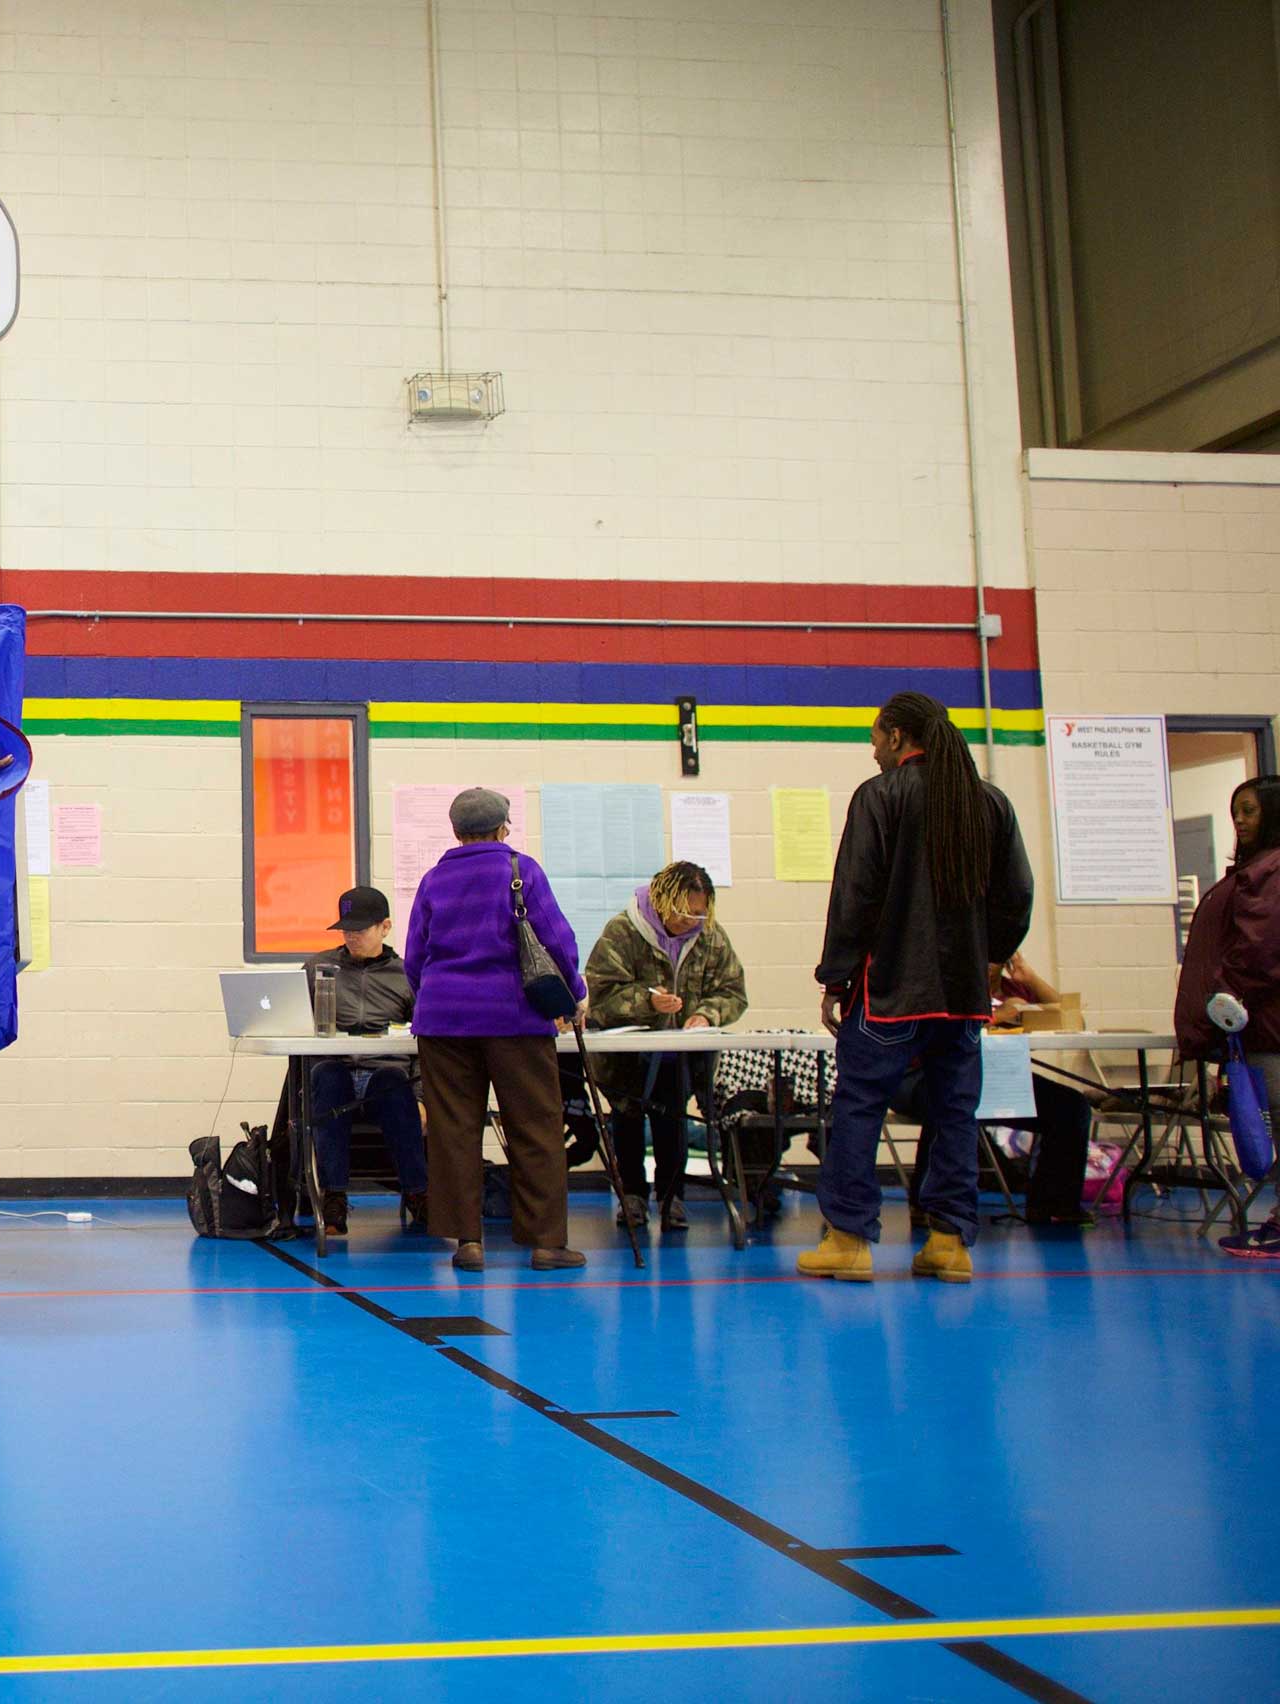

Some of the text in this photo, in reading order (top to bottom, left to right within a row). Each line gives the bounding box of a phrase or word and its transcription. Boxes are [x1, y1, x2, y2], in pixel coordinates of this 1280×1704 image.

[1077, 726, 1092, 734] WEST
[1094, 726, 1134, 734] PHILADELPHIA
[1136, 726, 1152, 734] YMCA
